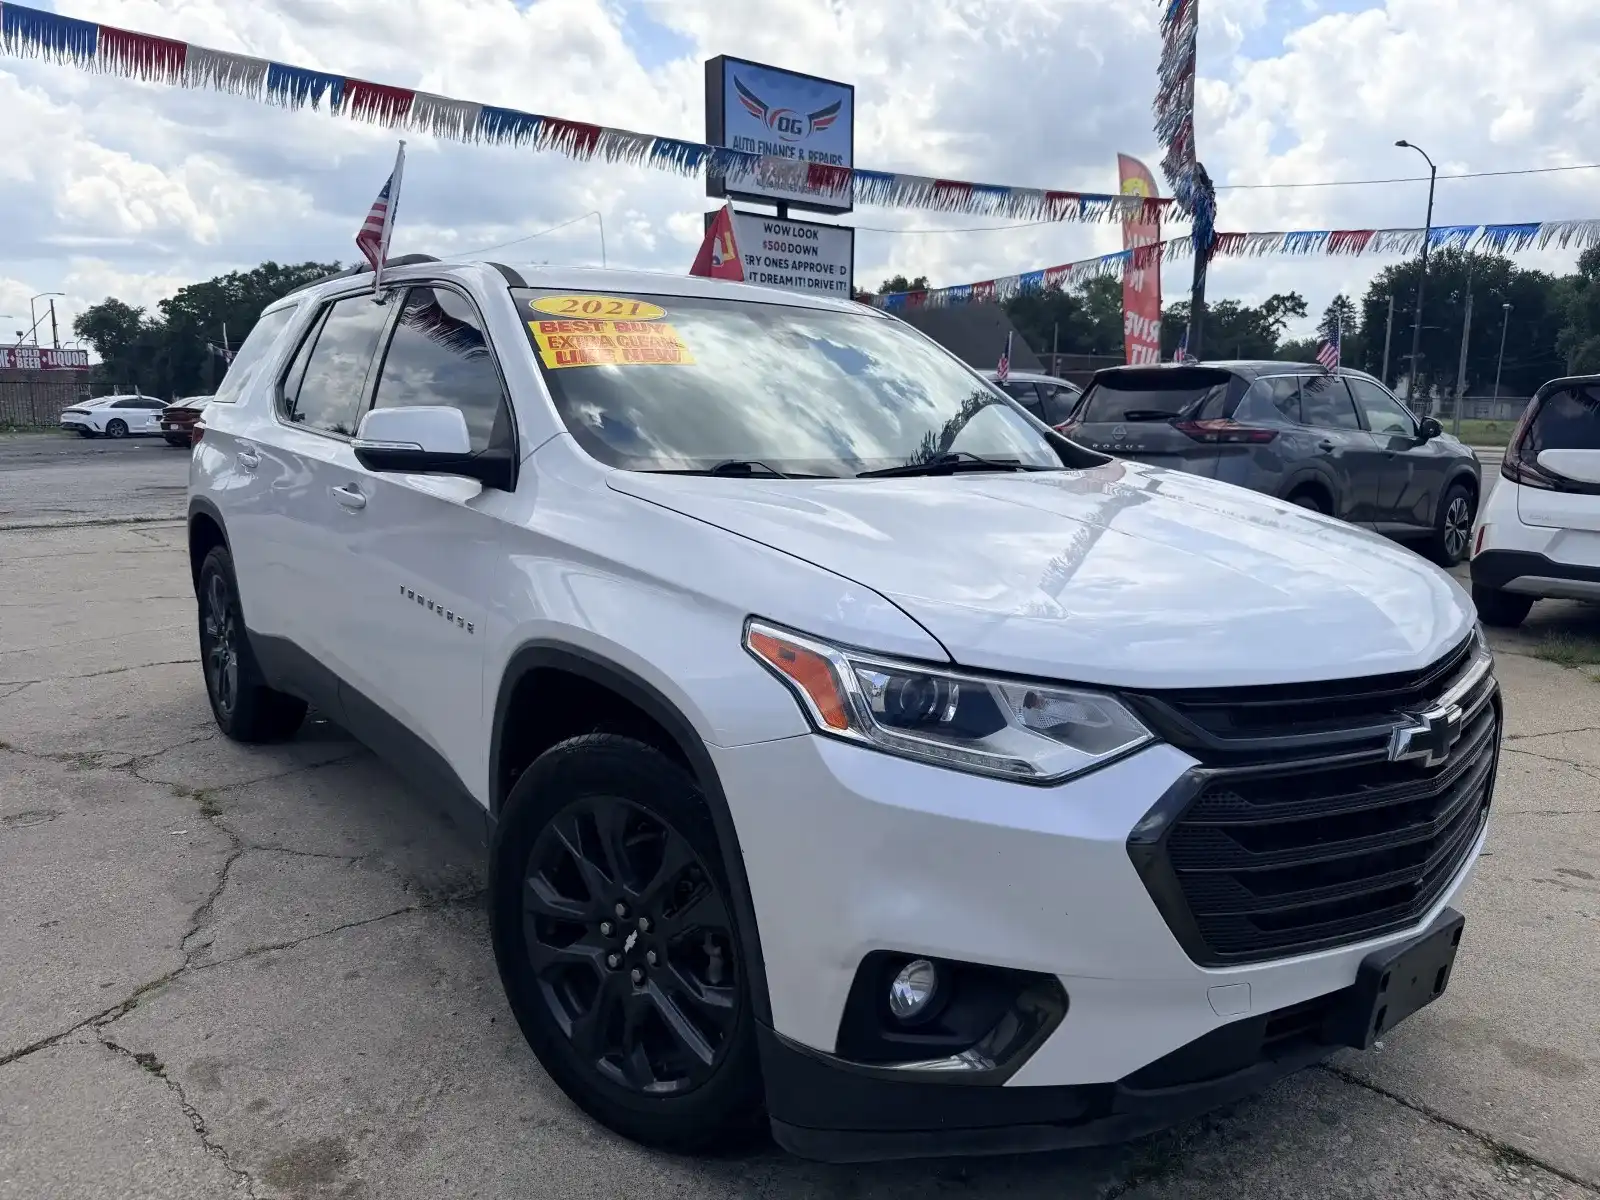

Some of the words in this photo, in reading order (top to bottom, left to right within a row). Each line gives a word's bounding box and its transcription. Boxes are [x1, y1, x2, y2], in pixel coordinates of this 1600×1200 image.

[777, 116, 803, 135] OG
[733, 135, 755, 152] AUTO
[757, 141, 796, 158] FINANCE
[798, 148, 805, 160] &
[808, 150, 843, 165] REPAIRS
[764, 222, 791, 238] WOW
[792, 227, 819, 240] LOOK
[762, 240, 787, 253] $500
[788, 243, 818, 256] DOWN
[764, 256, 789, 269] ONES
[760, 272, 793, 286] DREAM
[794, 275, 806, 287] IT!
[808, 276, 834, 290] DRIVE
[835, 279, 847, 291] IT!
[559, 299, 642, 316] 2021
[539, 320, 606, 334] BEST
[613, 321, 667, 334] BUY
[547, 335, 616, 349] EXTRA
[14, 349, 40, 357] COLD
[47, 351, 87, 367] LIQUOR
[622, 348, 682, 363] NEW
[16, 357, 41, 369] BEER
